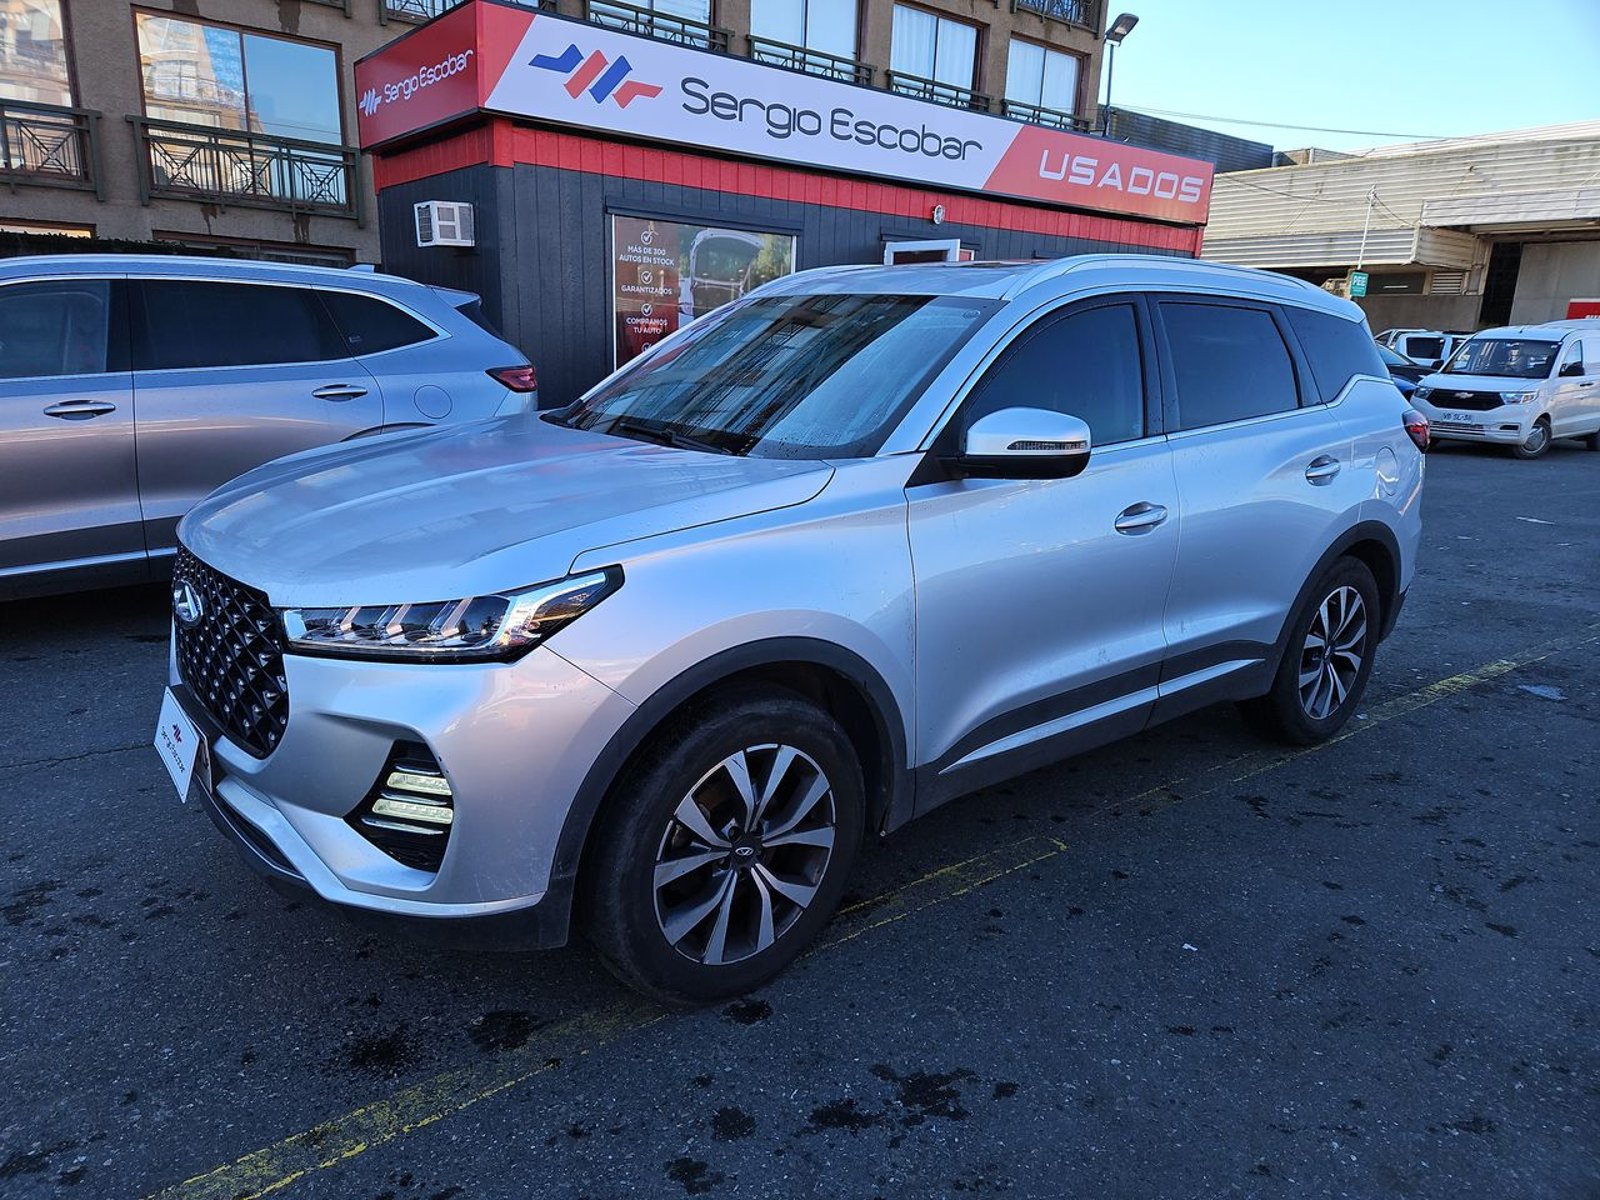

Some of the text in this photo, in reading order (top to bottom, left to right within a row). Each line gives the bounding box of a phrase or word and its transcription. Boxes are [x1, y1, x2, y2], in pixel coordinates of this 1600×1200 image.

[419, 49, 474, 87] Escobar
[681, 76, 983, 161] Sergio Escobar
[1039, 149, 1204, 203] USADOS
[627, 244, 642, 253] MÁS
[619, 254, 642, 263] AUTOS
[652, 257, 675, 266] STOCK
[621, 285, 672, 295] GARANTIZADOS
[626, 317, 668, 326] COMPRAMOS
[643, 327, 662, 335] AUTO
